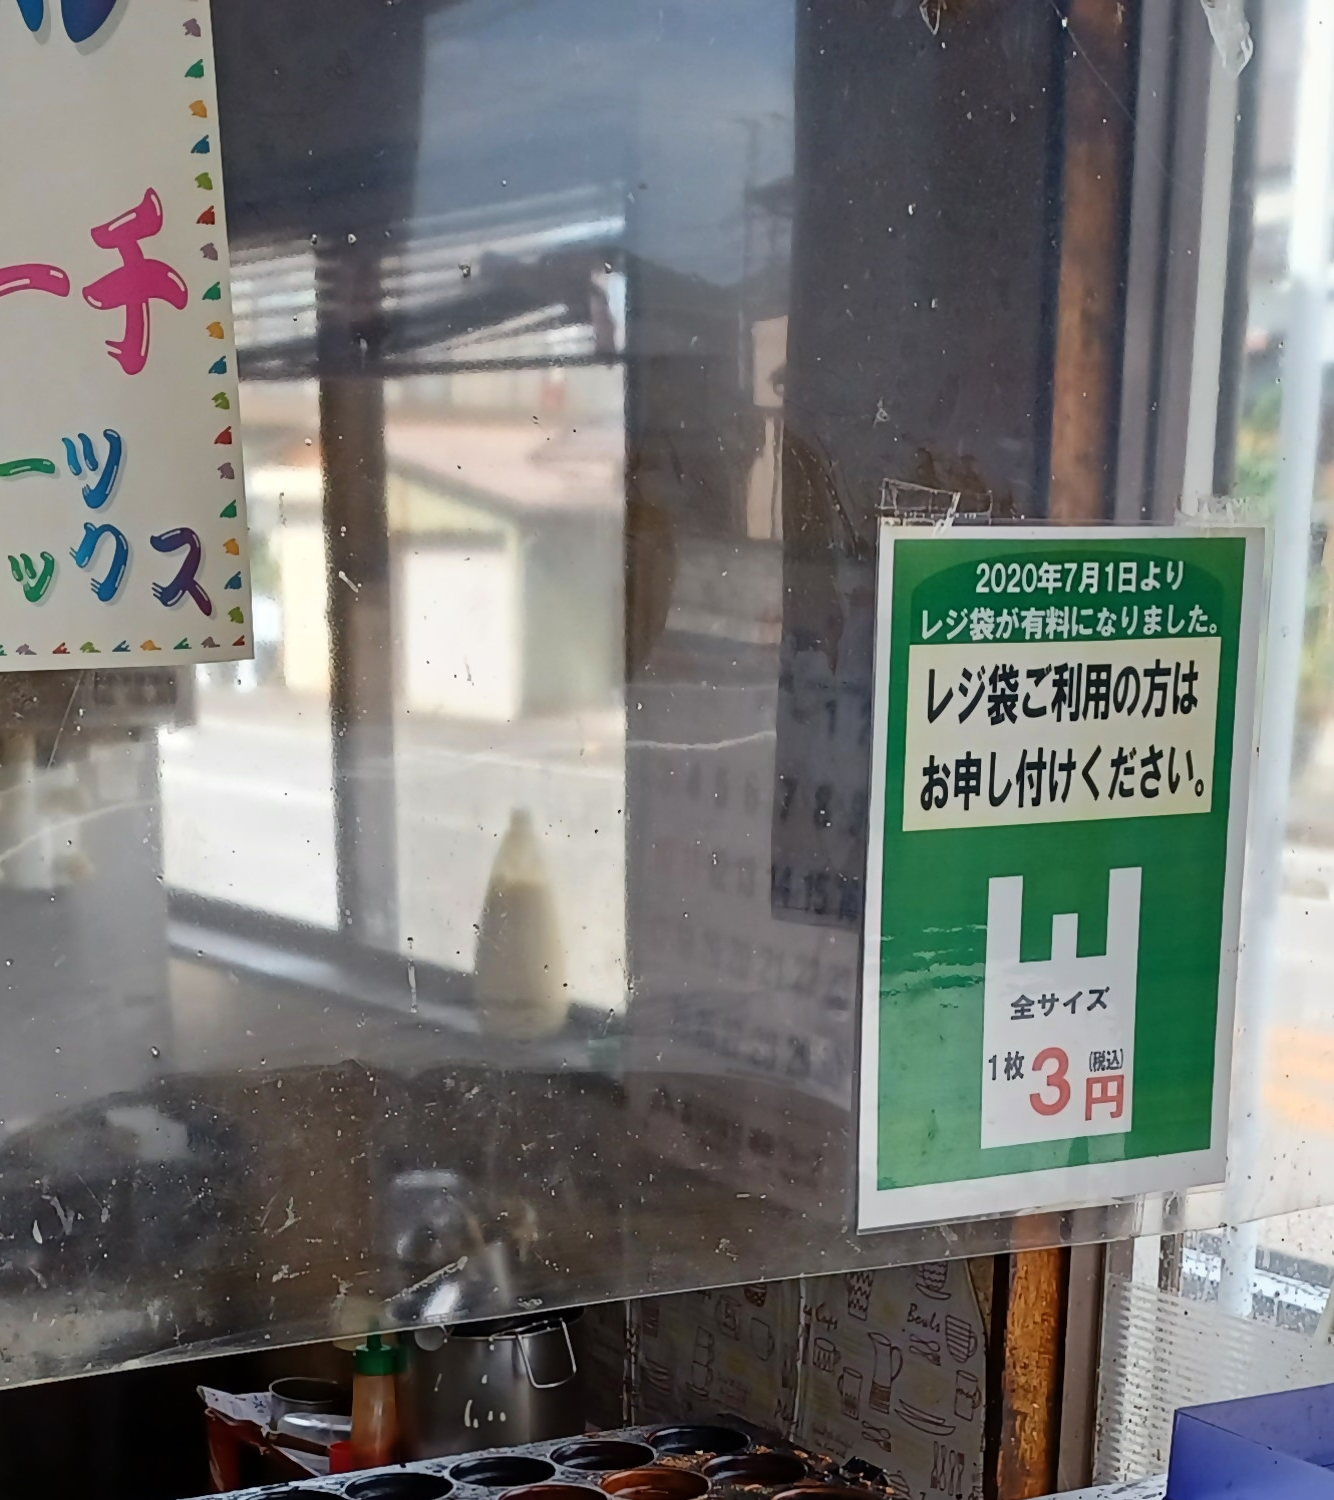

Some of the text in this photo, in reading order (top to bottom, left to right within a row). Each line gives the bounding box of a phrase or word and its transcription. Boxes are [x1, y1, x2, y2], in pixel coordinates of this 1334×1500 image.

[975, 561, 1185, 595] 2020年7月1日より
[921, 604, 1218, 641] レジ袋が有料になりました。
[927, 658, 1199, 726] レジ袋ご利用の方は
[920, 744, 1205, 812] お申し付けください。
[1010, 986, 1110, 1020] 全サイズ
